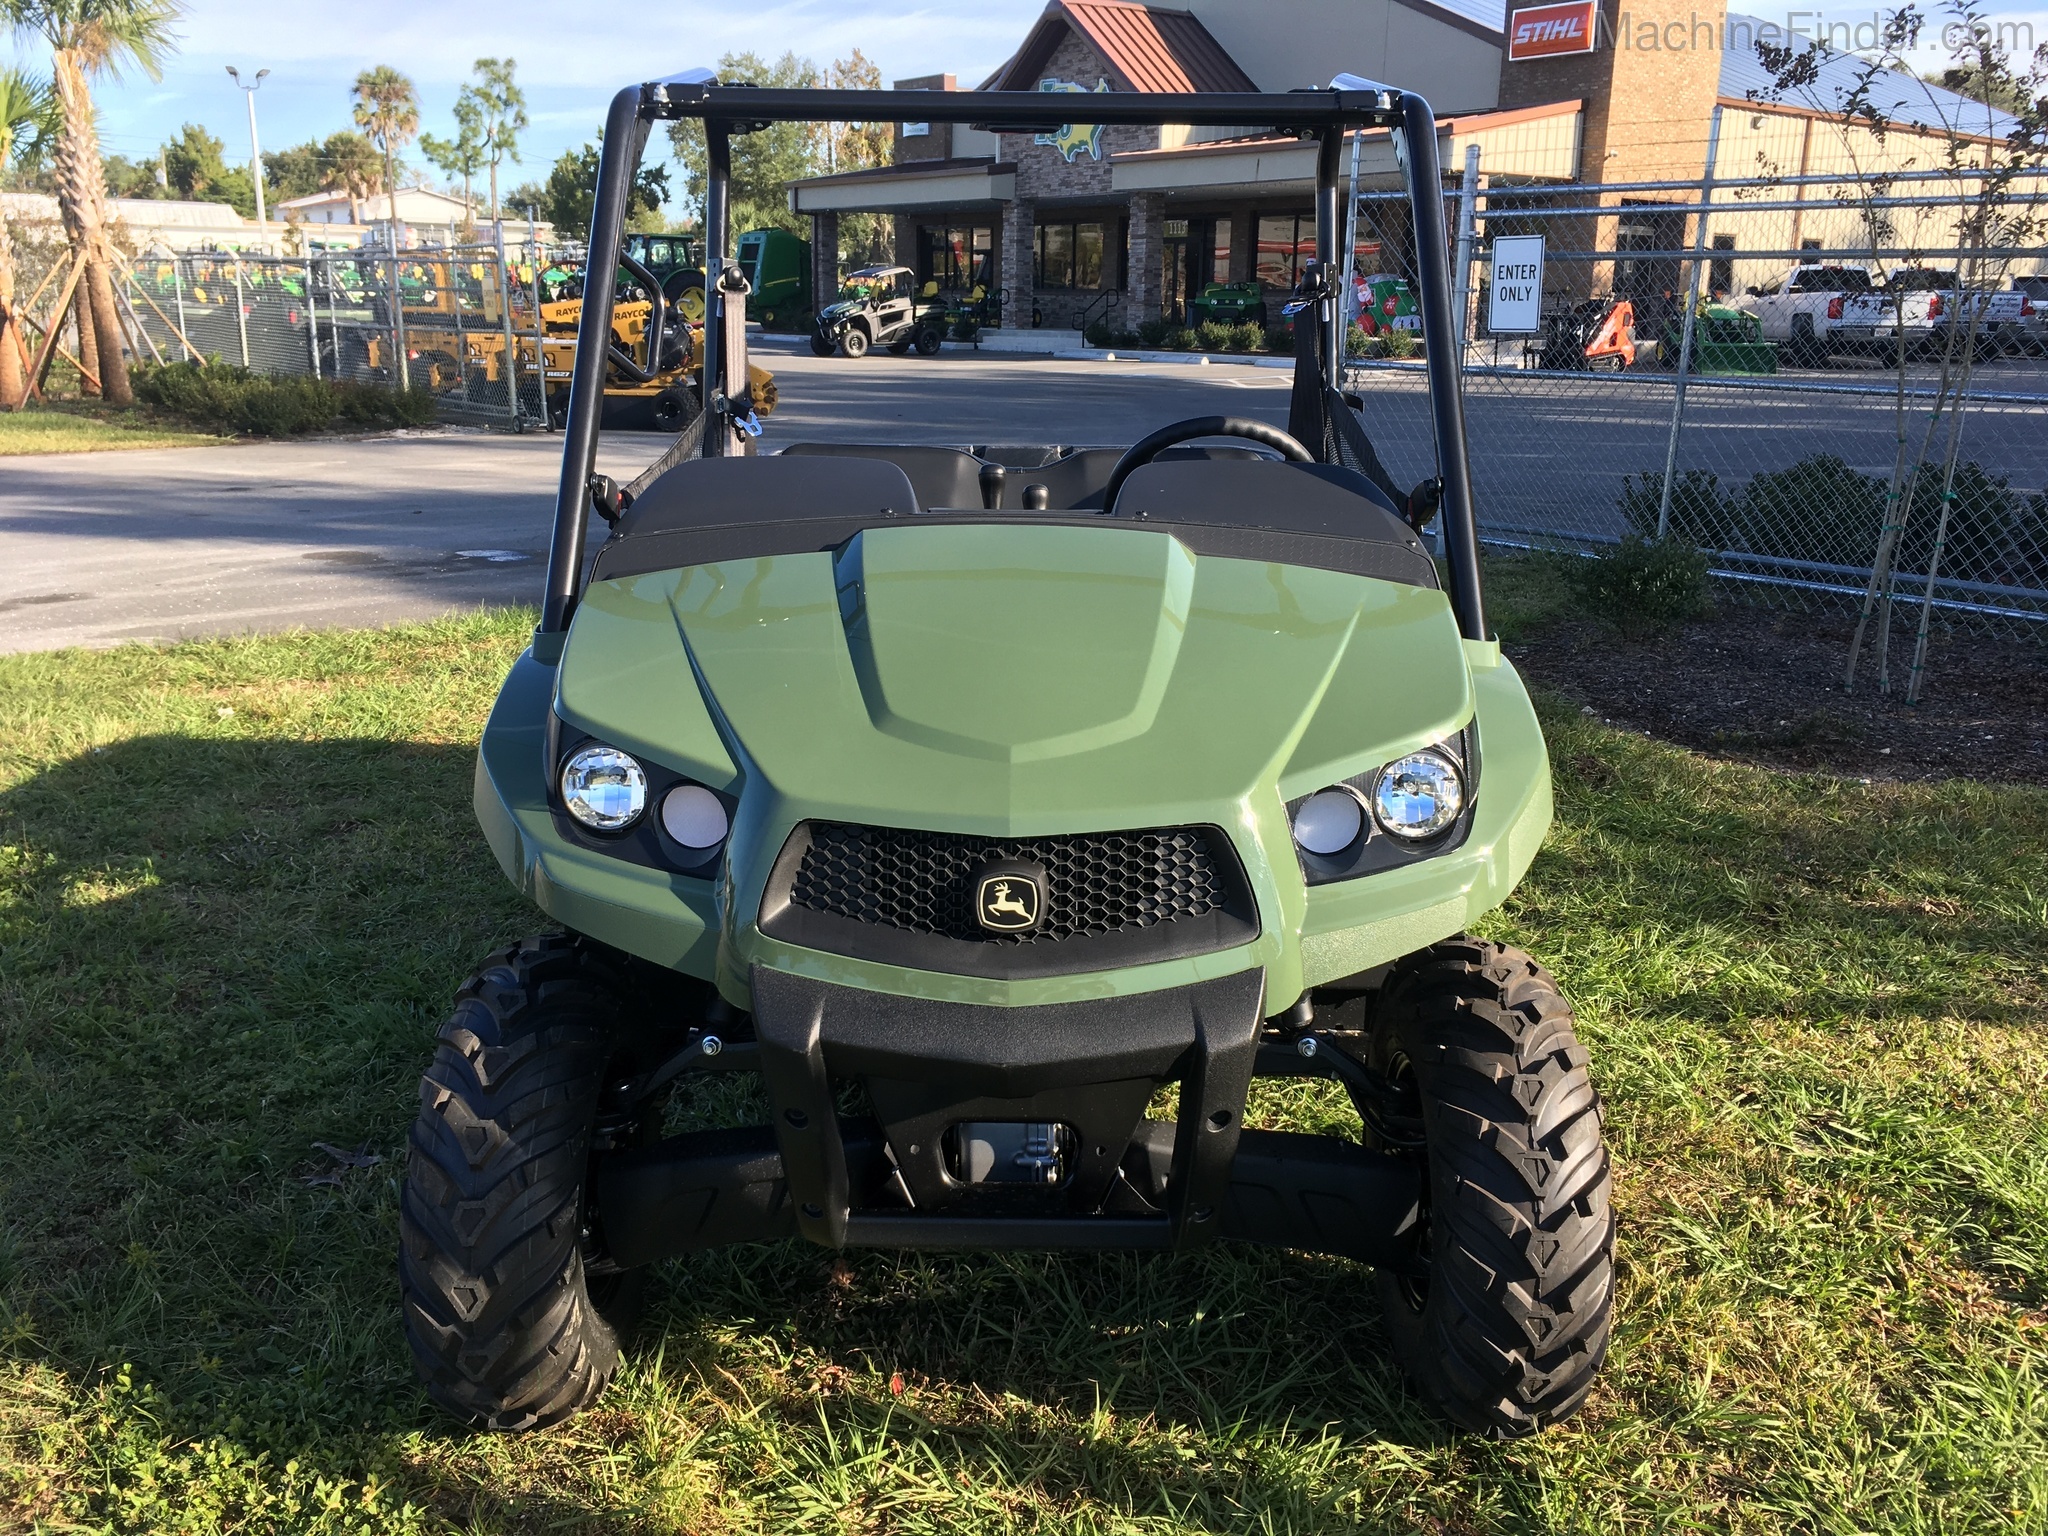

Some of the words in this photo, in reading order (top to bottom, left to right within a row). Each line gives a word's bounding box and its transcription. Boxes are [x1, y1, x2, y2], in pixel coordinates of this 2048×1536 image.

[1514, 16, 1583, 45] STIHL
[1498, 264, 1537, 280] ENTER
[1499, 285, 1533, 302] ONLY
[614, 308, 645, 320] RAYCO
